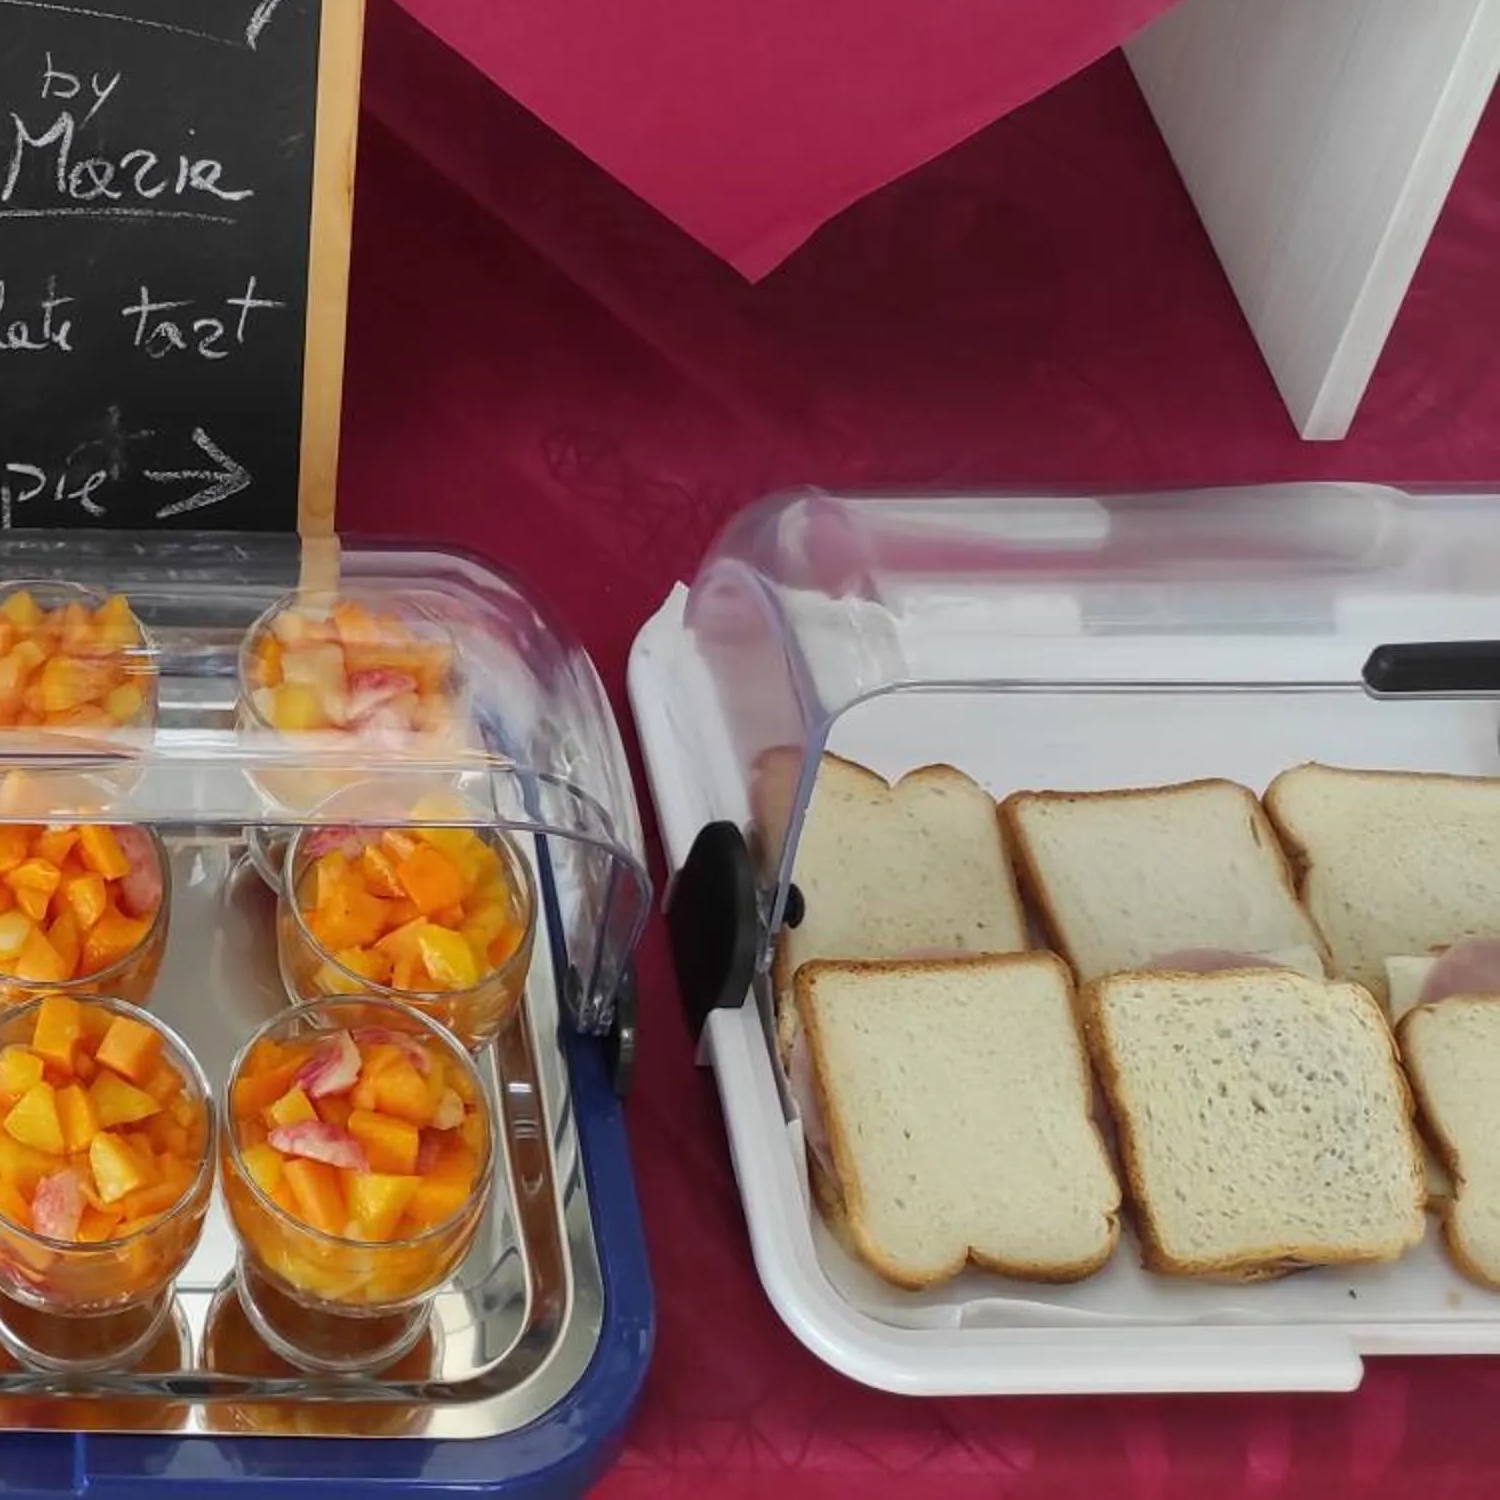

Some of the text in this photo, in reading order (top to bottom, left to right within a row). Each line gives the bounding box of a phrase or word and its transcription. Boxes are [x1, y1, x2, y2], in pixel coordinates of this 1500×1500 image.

[41, 51, 122, 131] by
[1, 111, 255, 201] Maria
[121, 276, 288, 359] tart
